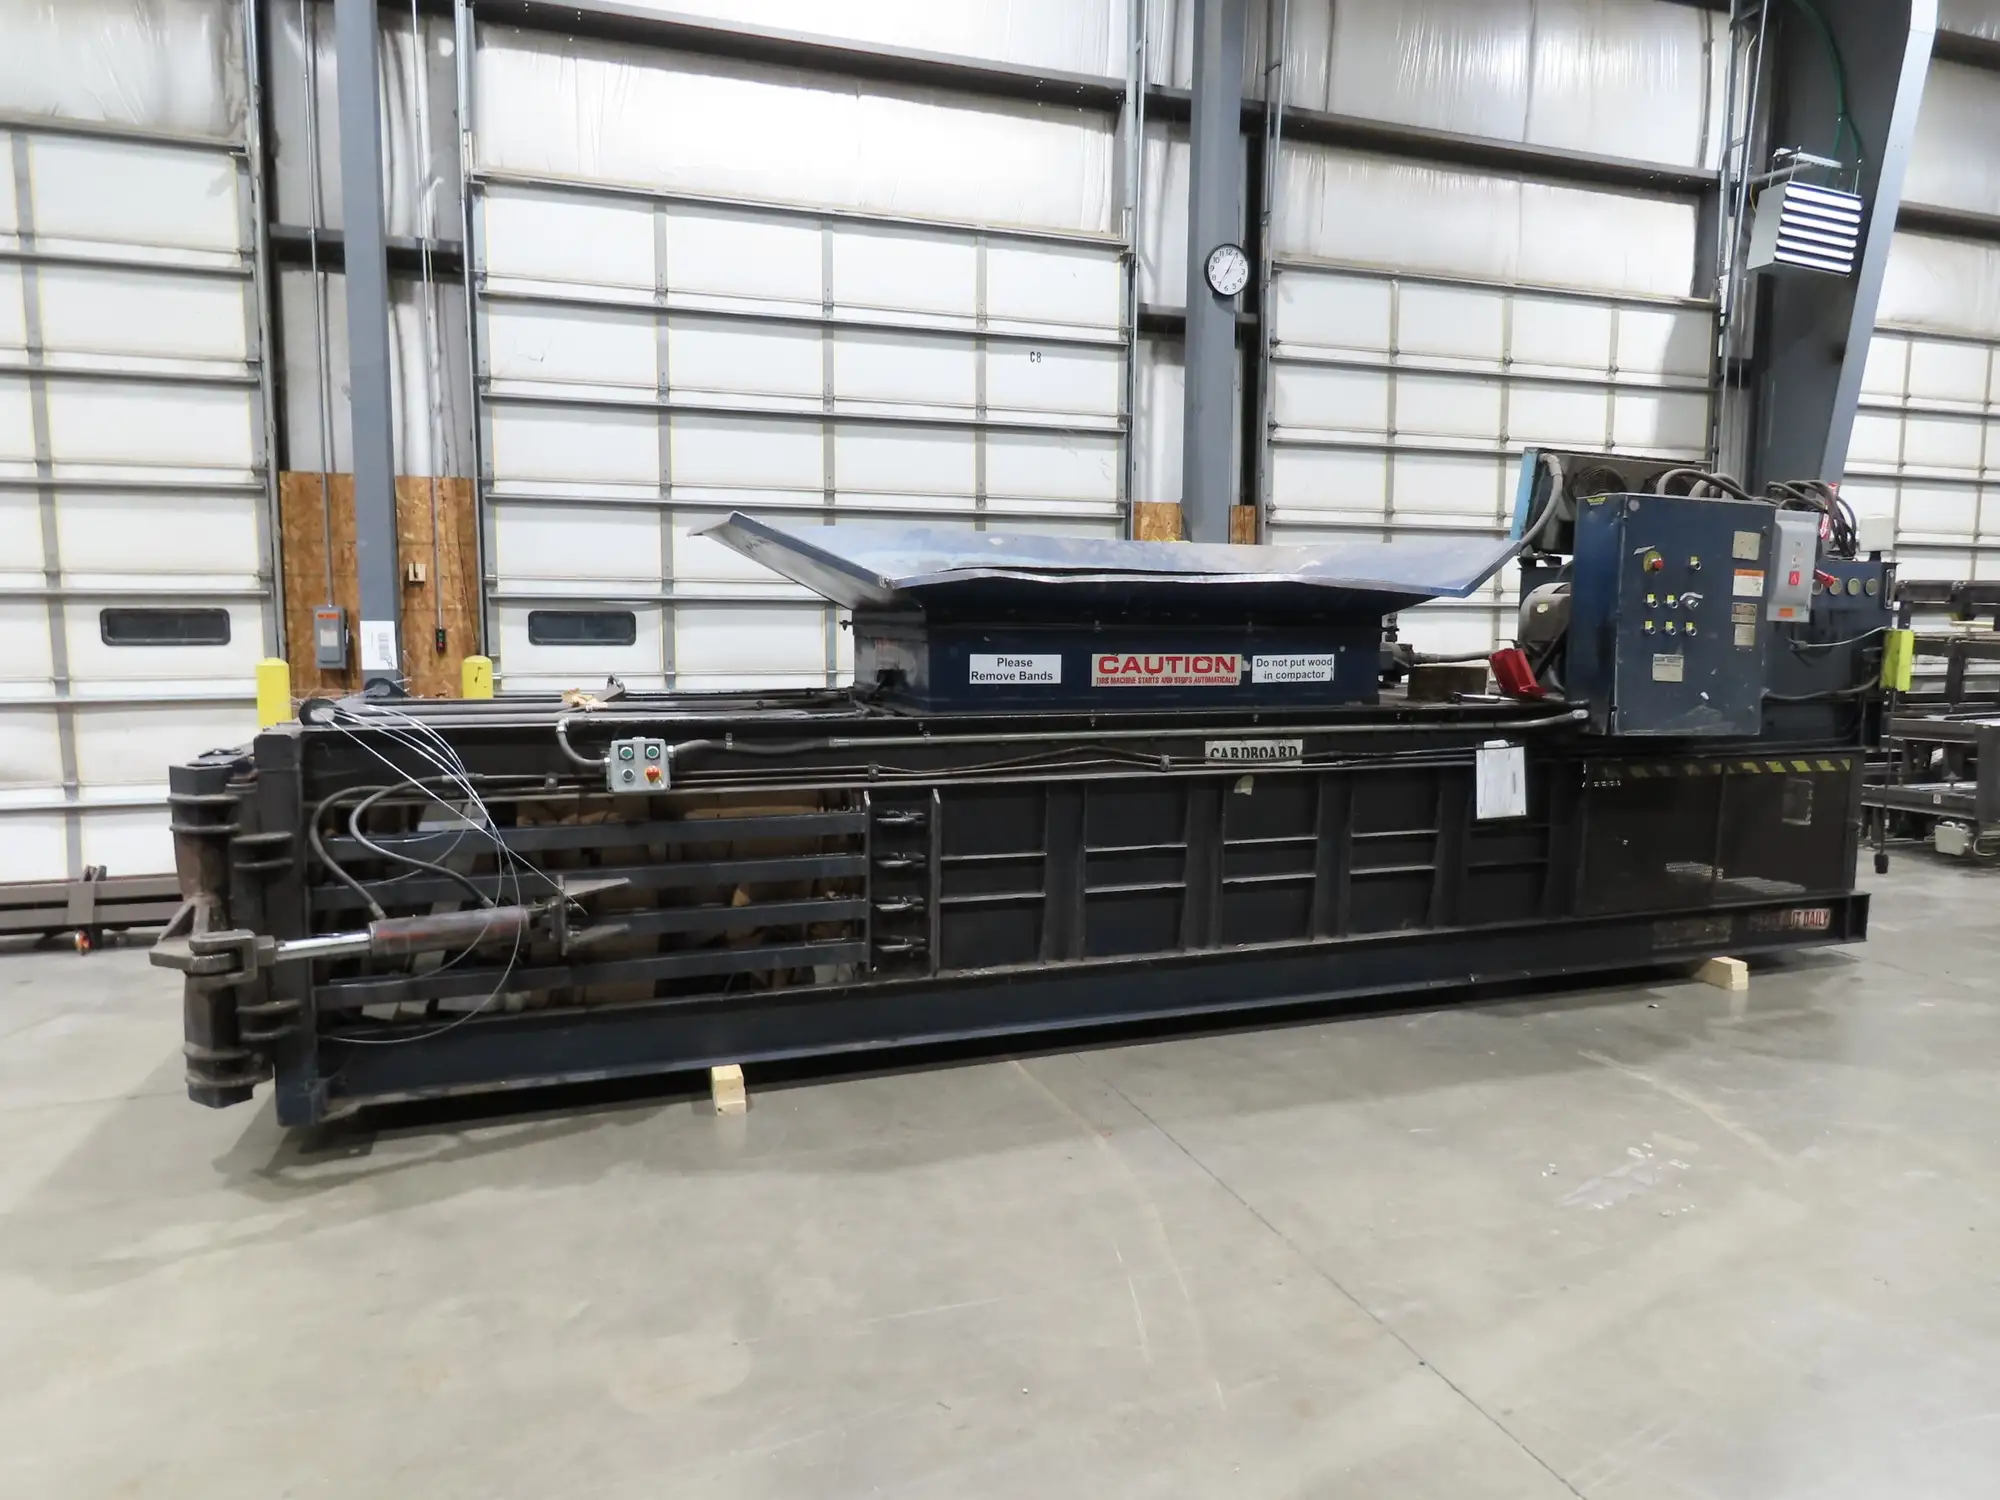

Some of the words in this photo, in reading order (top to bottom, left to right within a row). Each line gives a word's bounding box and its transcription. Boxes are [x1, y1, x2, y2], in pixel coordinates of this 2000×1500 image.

[1030, 351, 1042, 364] C8
[997, 657, 1033, 668] Please
[1098, 656, 1236, 674] CAUTION
[1256, 658, 1270, 668] Do
[1272, 658, 1288, 667] not
[1290, 658, 1306, 669] put
[1308, 657, 1333, 667] wood
[971, 671, 1016, 681] Remove
[1019, 671, 1054, 681] Bands
[1193, 676, 1237, 684] AUTOMATICALLY
[1264, 670, 1273, 680] in
[1275, 669, 1326, 681] compactor
[1210, 745, 1298, 759] CARDBOARD
[1803, 910, 1830, 927] DAILY
